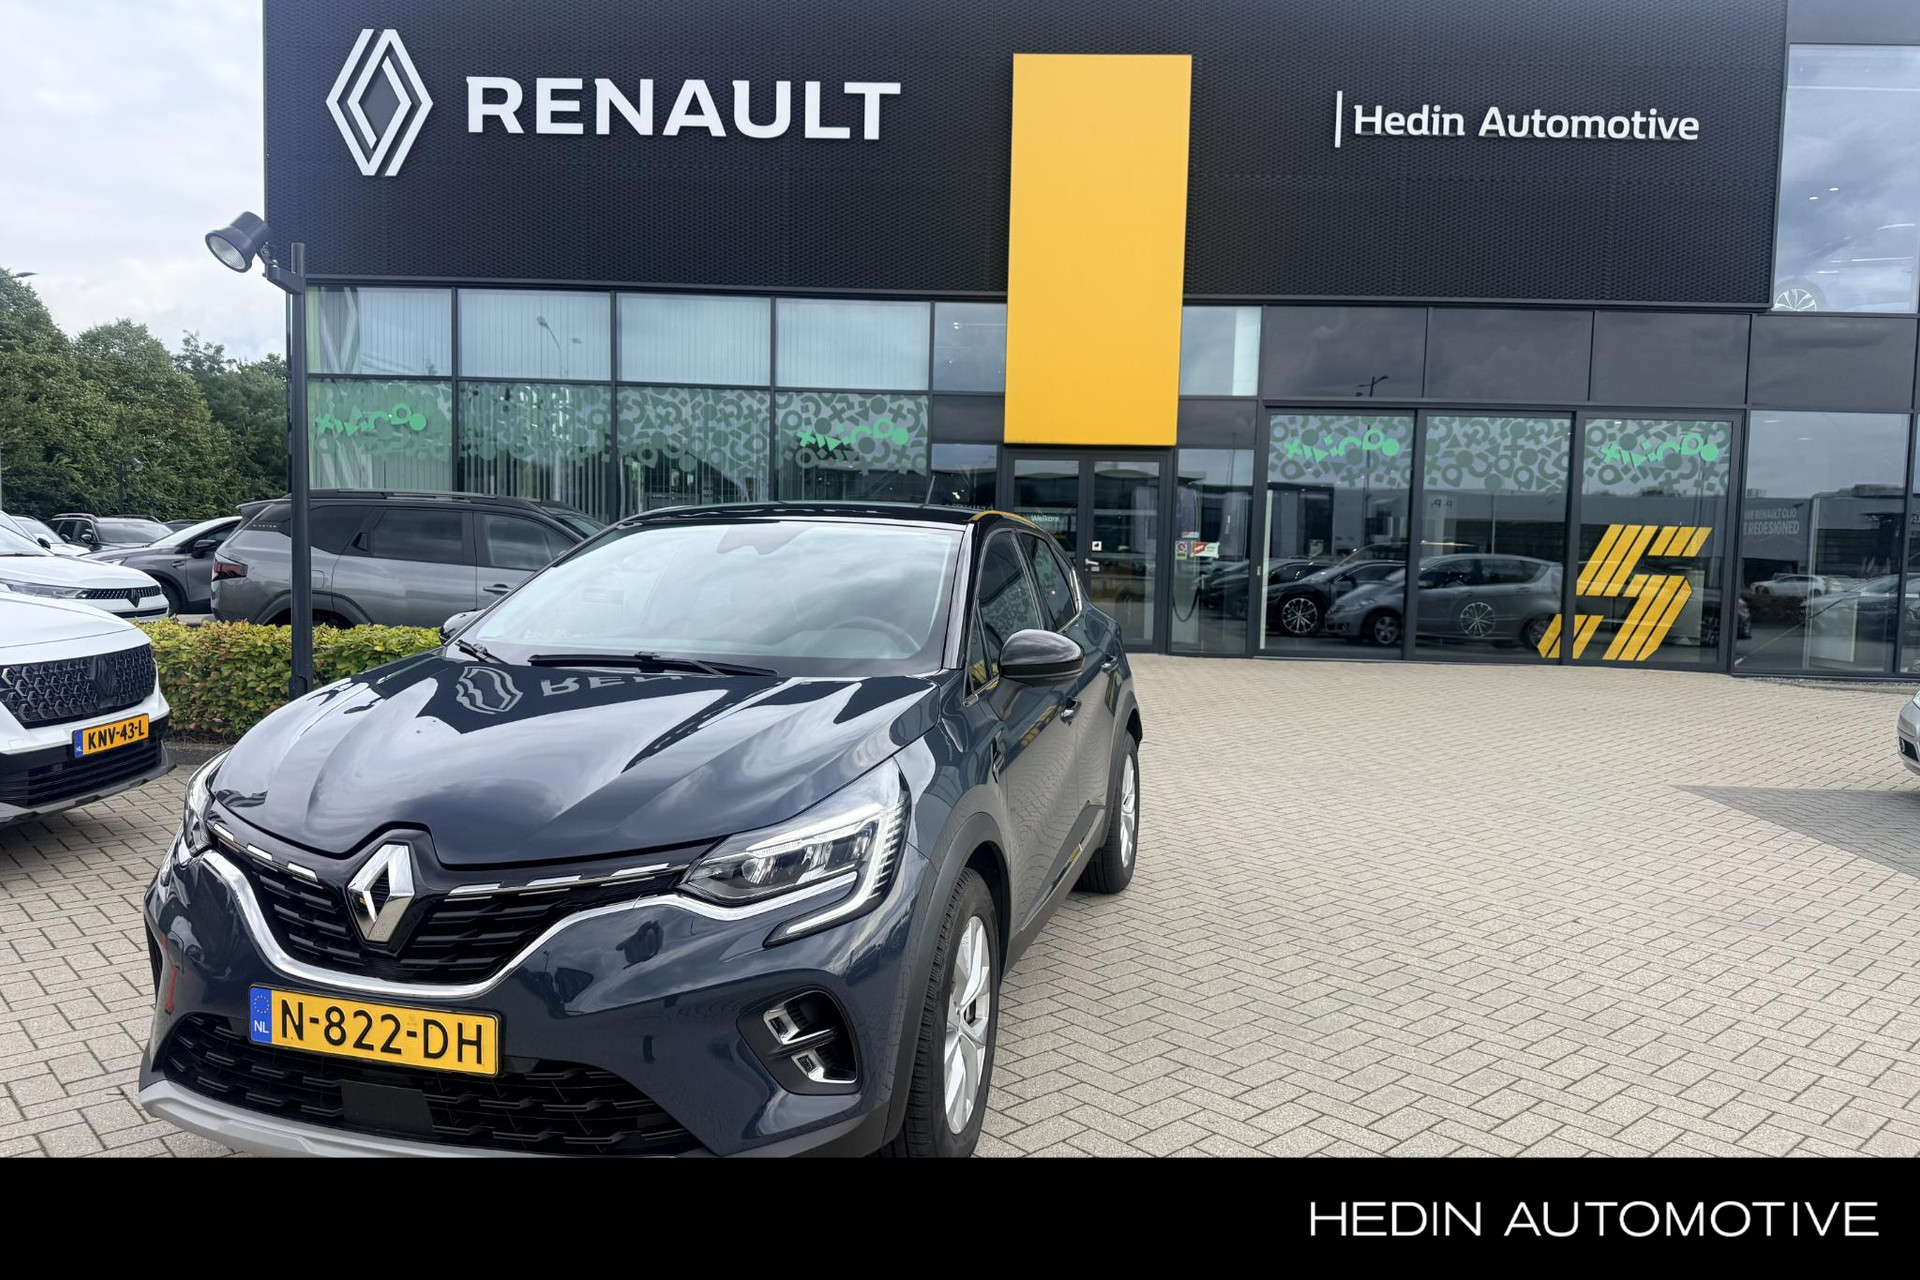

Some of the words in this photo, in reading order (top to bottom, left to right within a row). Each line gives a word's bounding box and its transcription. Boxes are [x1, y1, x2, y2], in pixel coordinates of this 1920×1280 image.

[466, 76, 901, 140] RENAULT
[1353, 104, 1465, 136] Hedin
[1478, 106, 1700, 140] Automotive
[1749, 520, 1800, 535] REDESIGNED
[88, 720, 145, 750] KNV-43-L
[254, 1019, 270, 1034] NL
[281, 999, 483, 1065] N-822-DH
